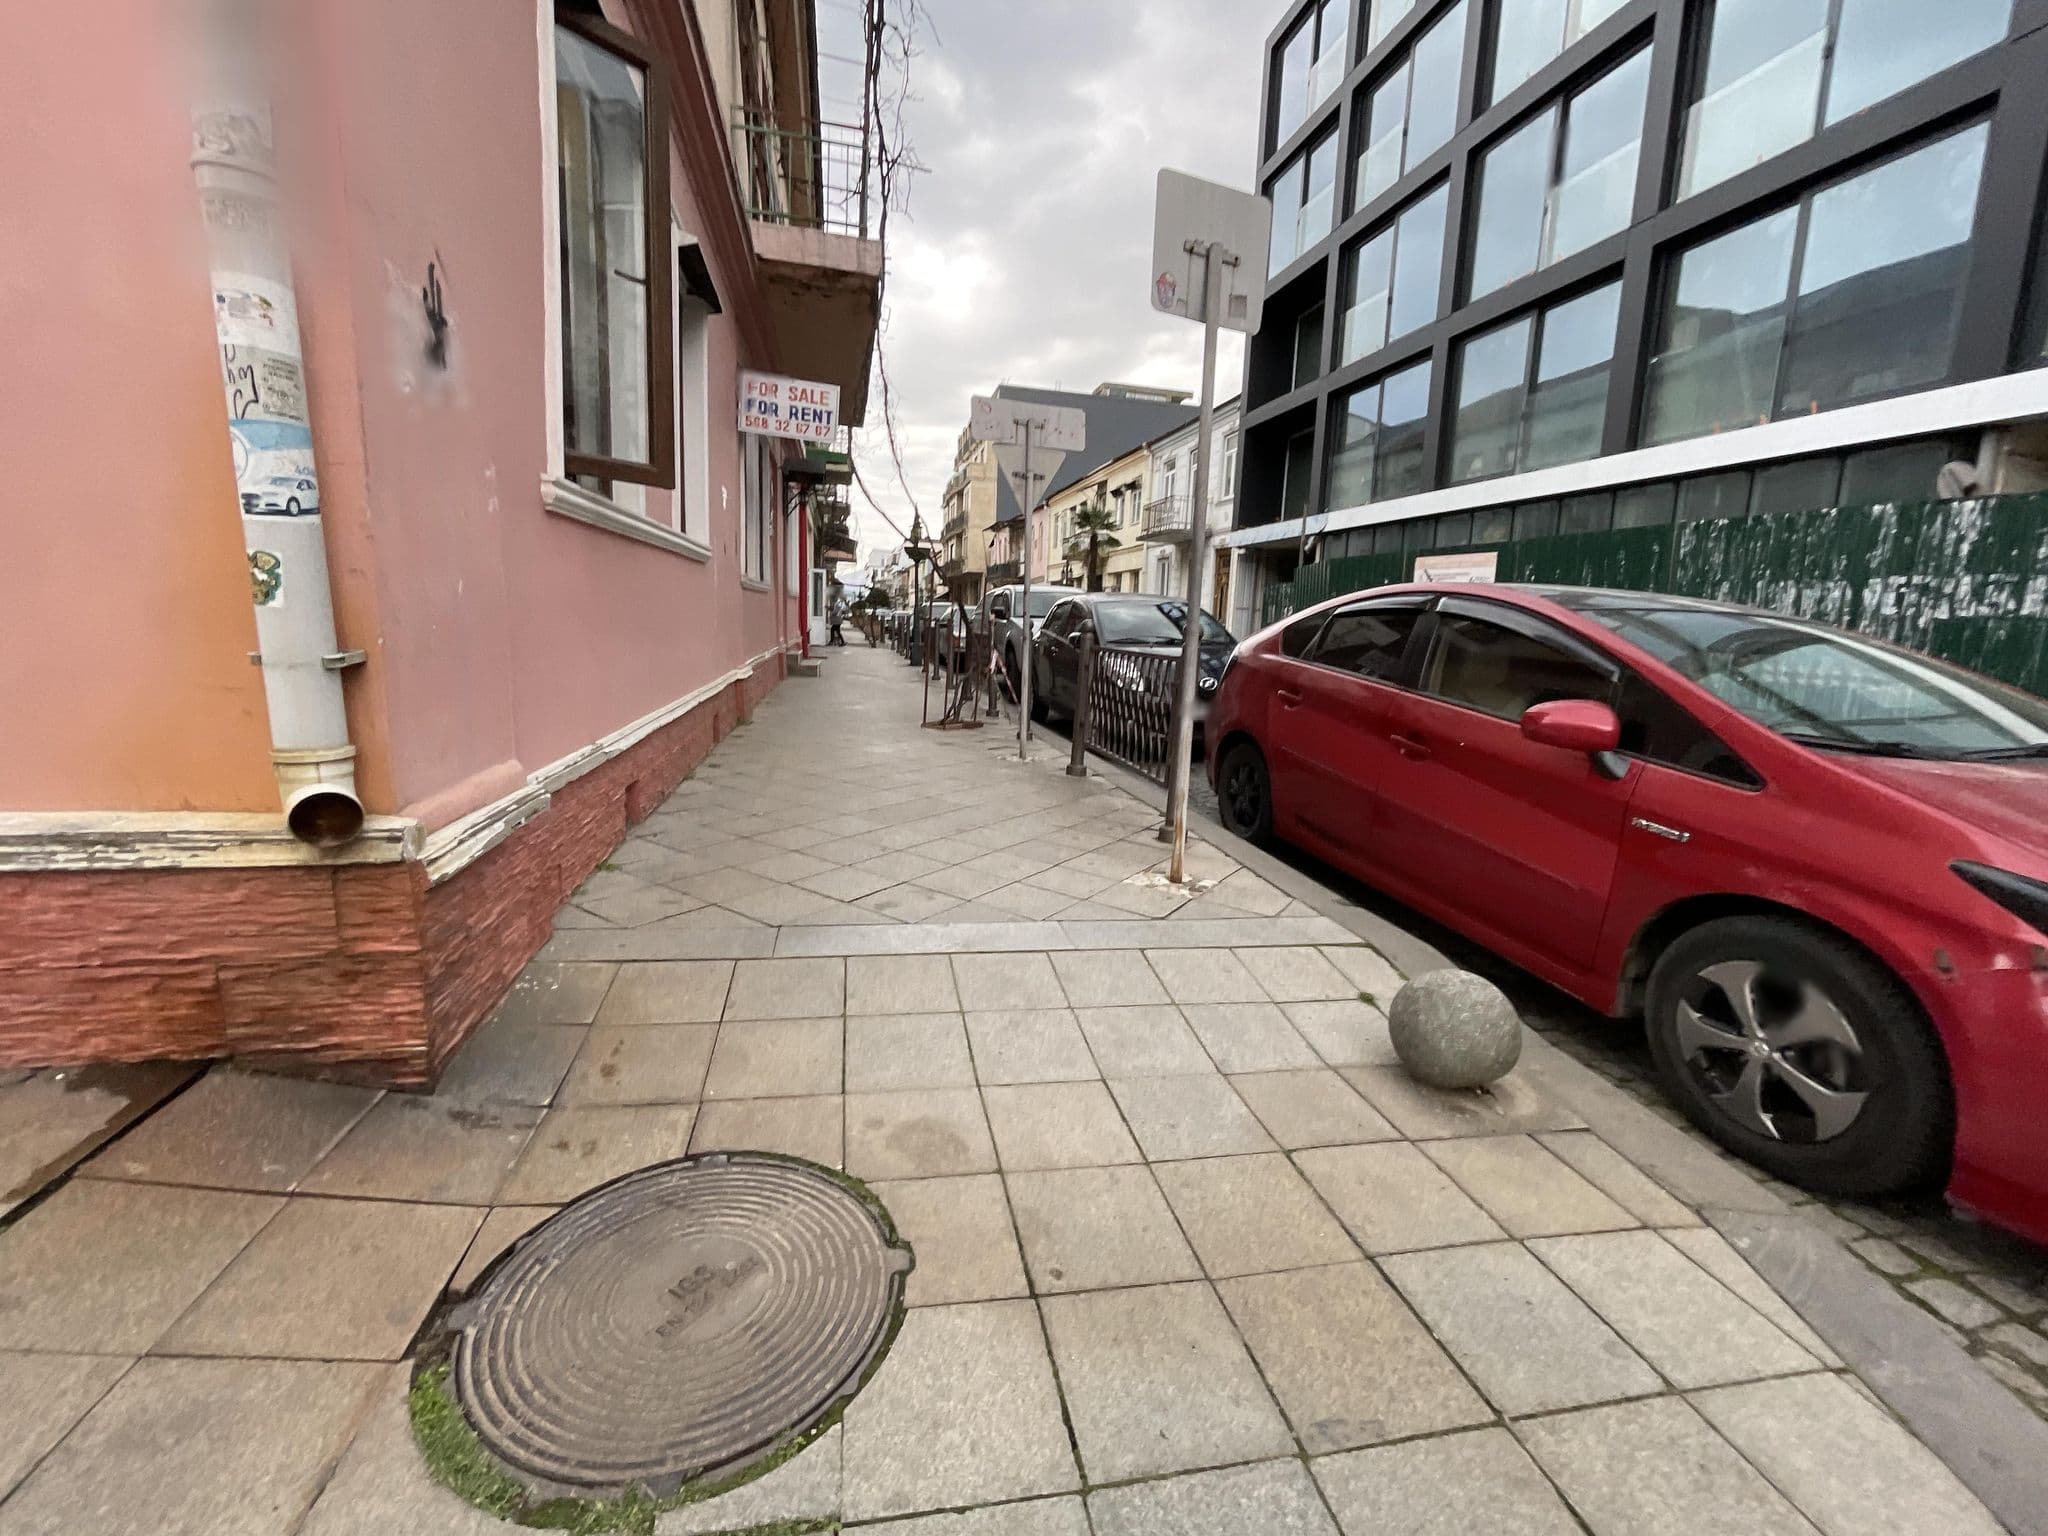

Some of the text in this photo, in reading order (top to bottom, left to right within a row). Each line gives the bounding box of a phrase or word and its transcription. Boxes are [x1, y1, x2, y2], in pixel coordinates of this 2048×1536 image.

[747, 381, 831, 406] FOR SALE
[745, 397, 833, 425] FOR RENT
